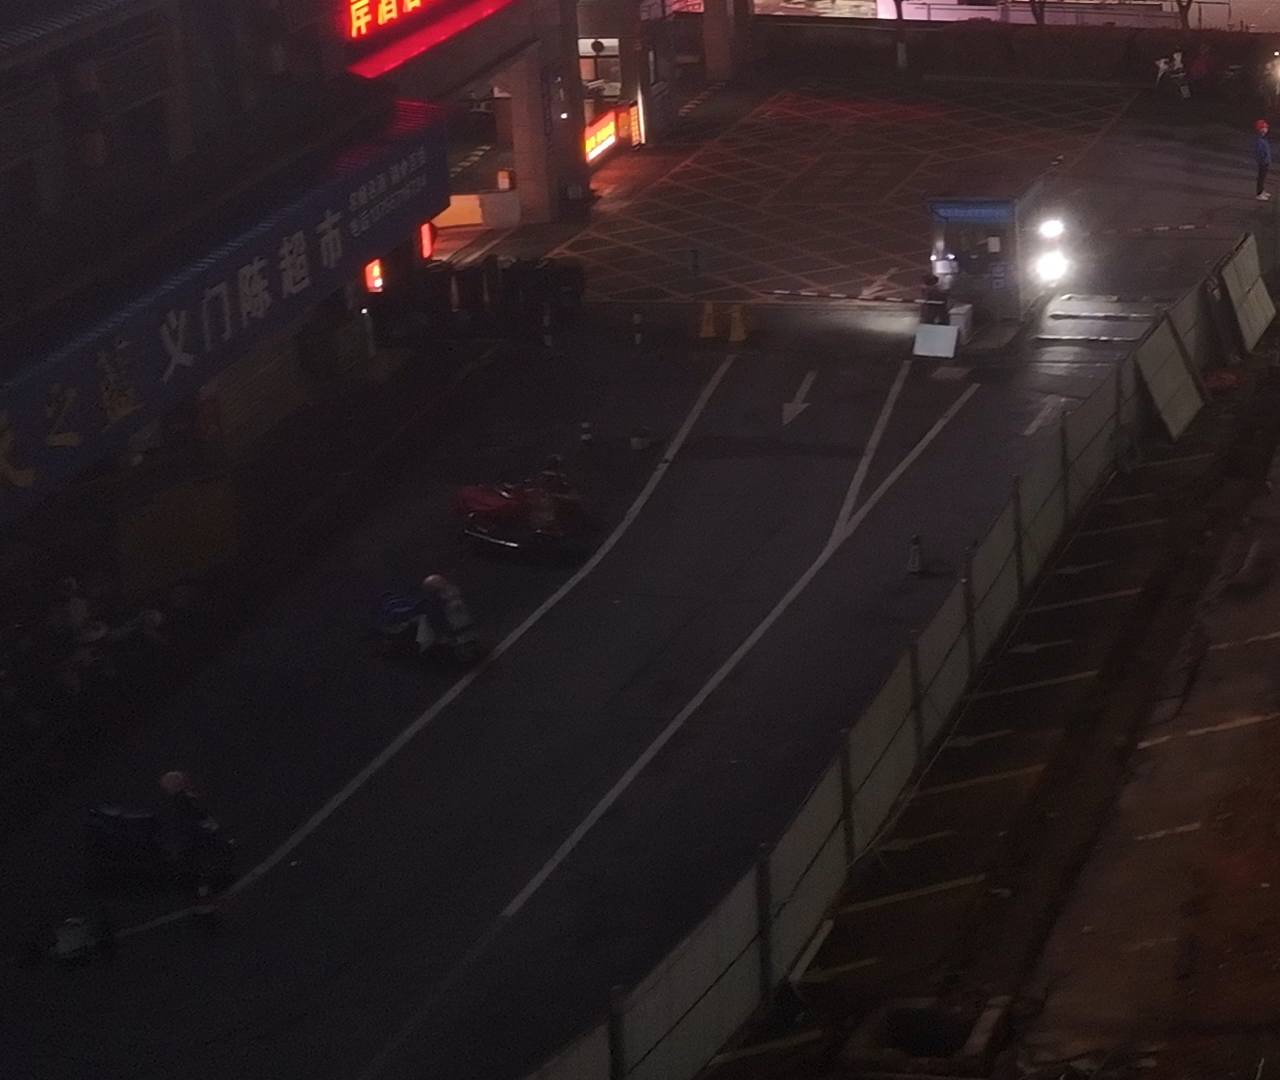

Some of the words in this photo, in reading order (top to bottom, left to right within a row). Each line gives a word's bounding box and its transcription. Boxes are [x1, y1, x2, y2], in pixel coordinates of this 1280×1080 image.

[159, 208, 346, 384] 义门陈超市
